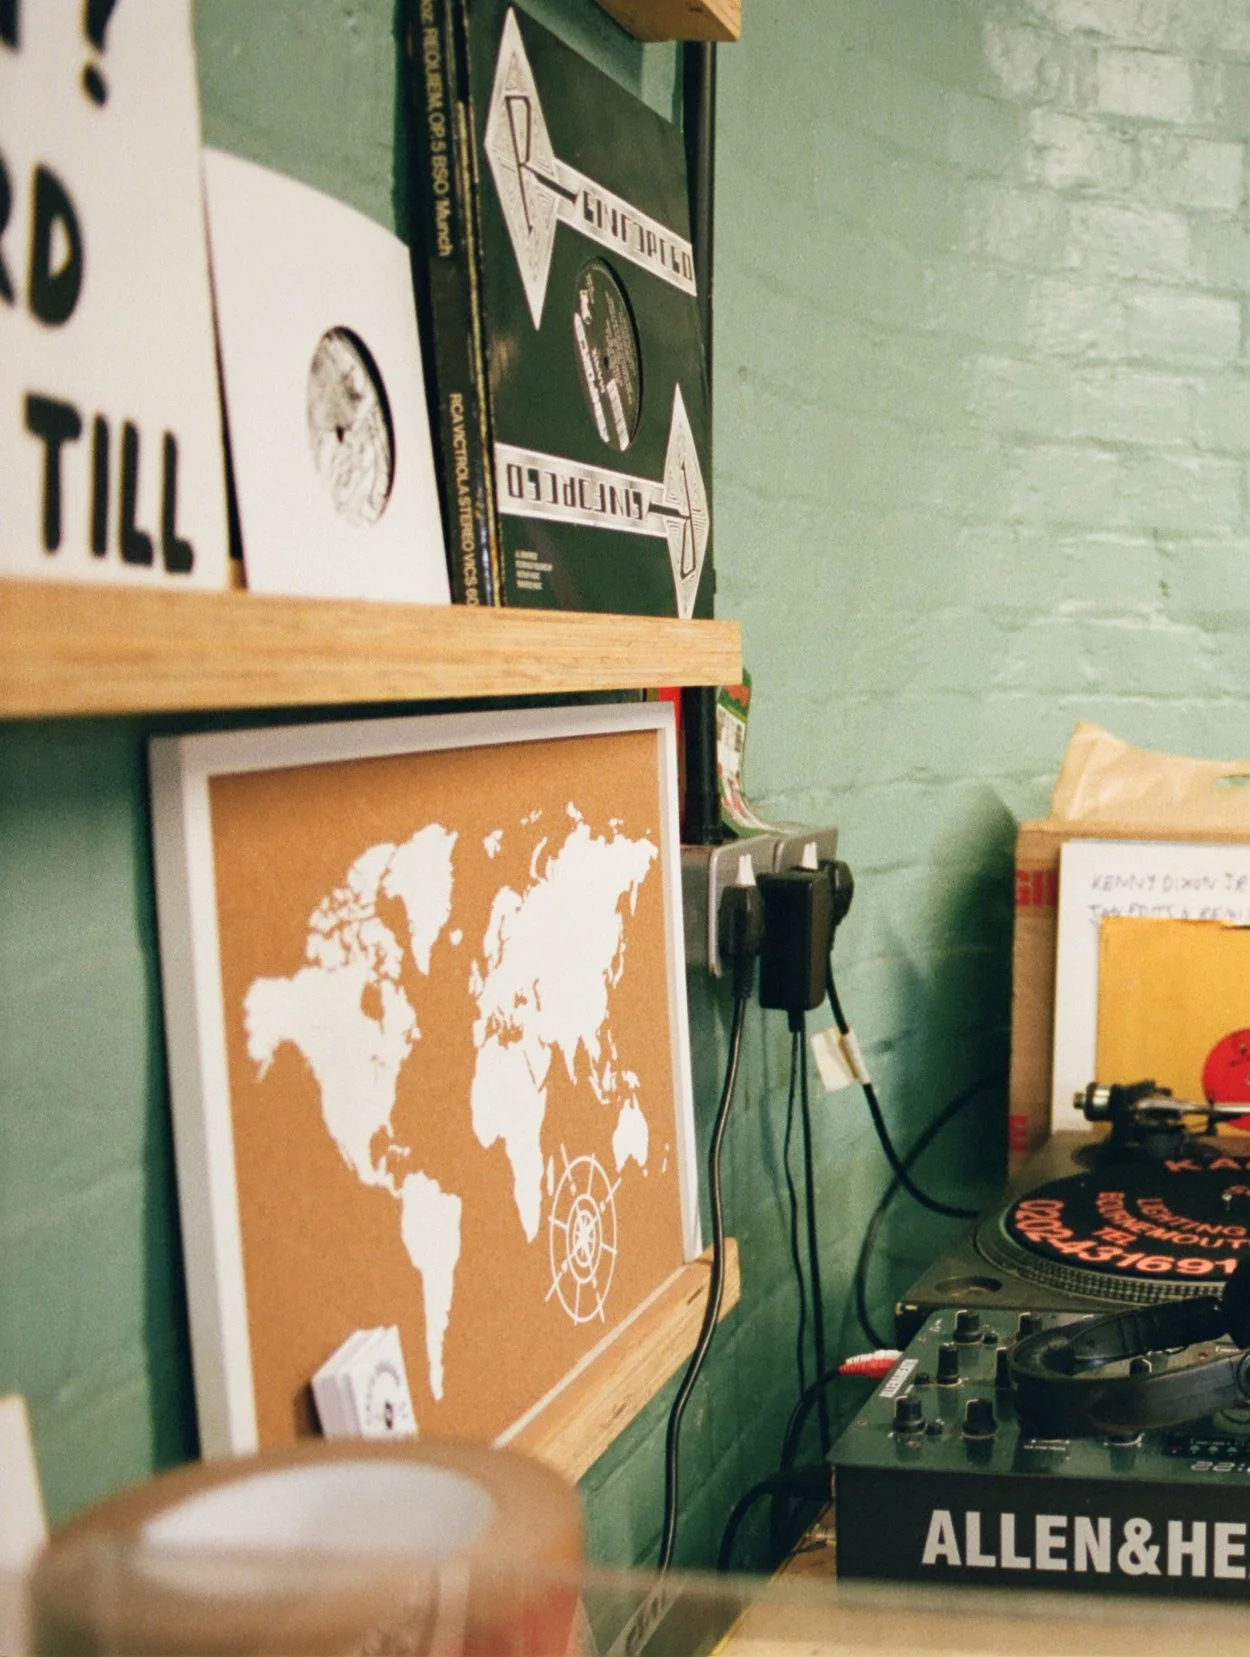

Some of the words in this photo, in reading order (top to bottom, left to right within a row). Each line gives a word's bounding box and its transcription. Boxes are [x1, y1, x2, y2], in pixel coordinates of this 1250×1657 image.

[449, 392, 464, 424] RCA
[24, 391, 194, 574] TILL
[452, 424, 470, 495] VICTROLA
[458, 496, 475, 551] STEREO
[1091, 873, 1157, 893] KENNY
[1162, 873, 1218, 893] DIXON
